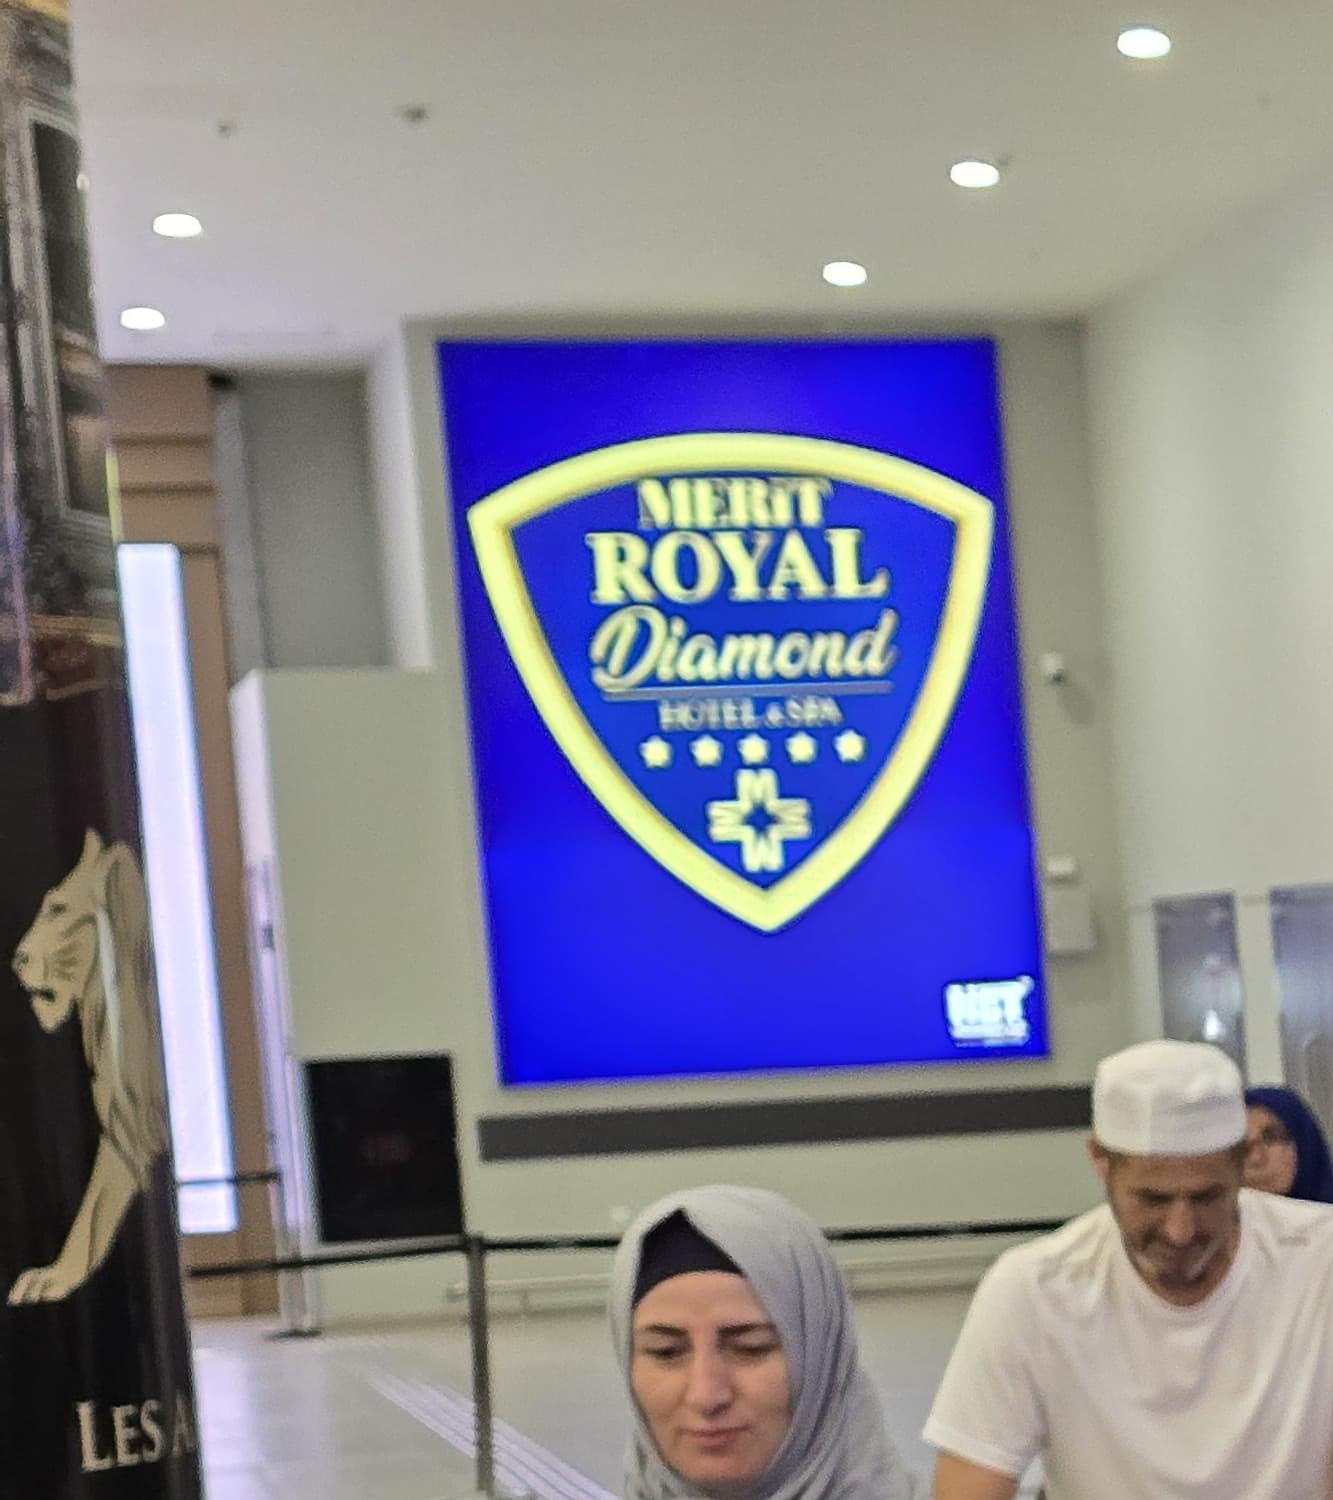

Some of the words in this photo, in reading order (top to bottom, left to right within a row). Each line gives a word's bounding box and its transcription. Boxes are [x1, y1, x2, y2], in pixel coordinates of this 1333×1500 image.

[637, 476, 834, 530] MERIT
[585, 528, 891, 604] ROYAL
[589, 602, 899, 693] Diamond
[658, 697, 761, 732] HOTEL
[75, 1399, 165, 1472] LES
